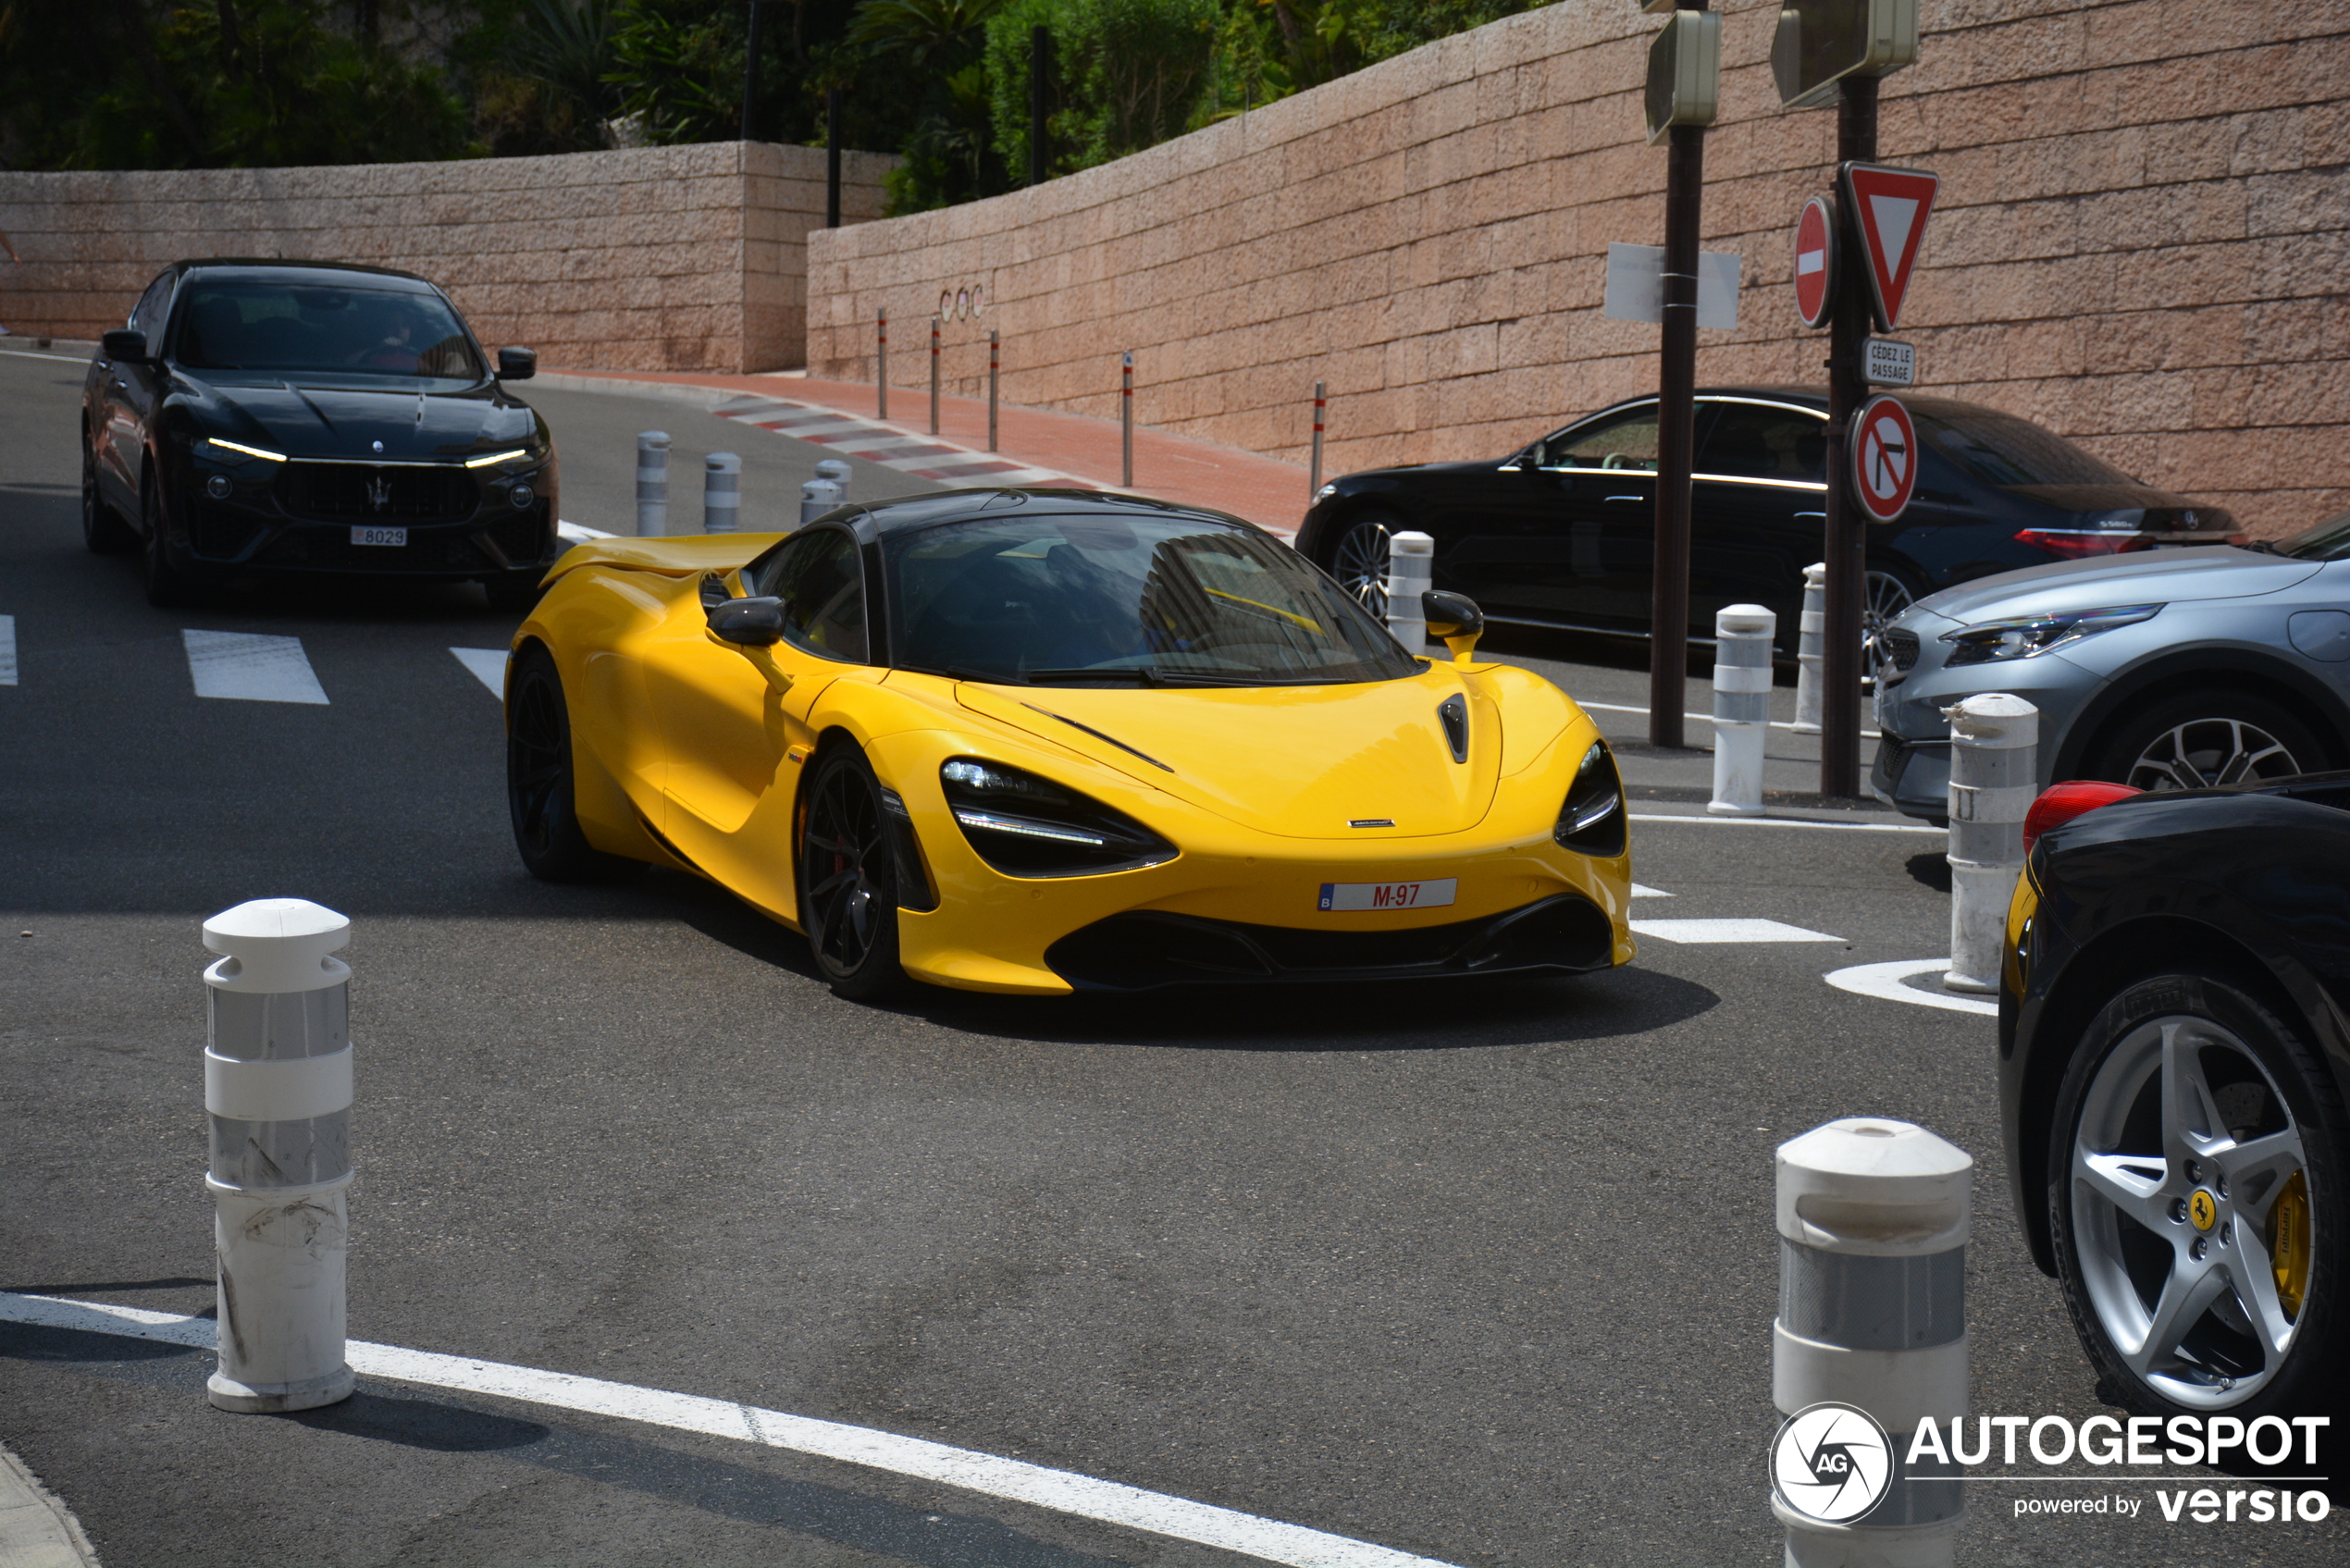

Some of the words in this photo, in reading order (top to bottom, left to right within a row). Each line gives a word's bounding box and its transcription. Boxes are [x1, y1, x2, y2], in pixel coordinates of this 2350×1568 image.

[1872, 343, 1897, 361] CÉDEZ
[1900, 349, 1911, 363] LE
[1872, 363, 1908, 380] PASSAGE
[365, 530, 404, 544] 8029
[1321, 898, 1330, 907] B
[1373, 884, 1420, 907] M-97
